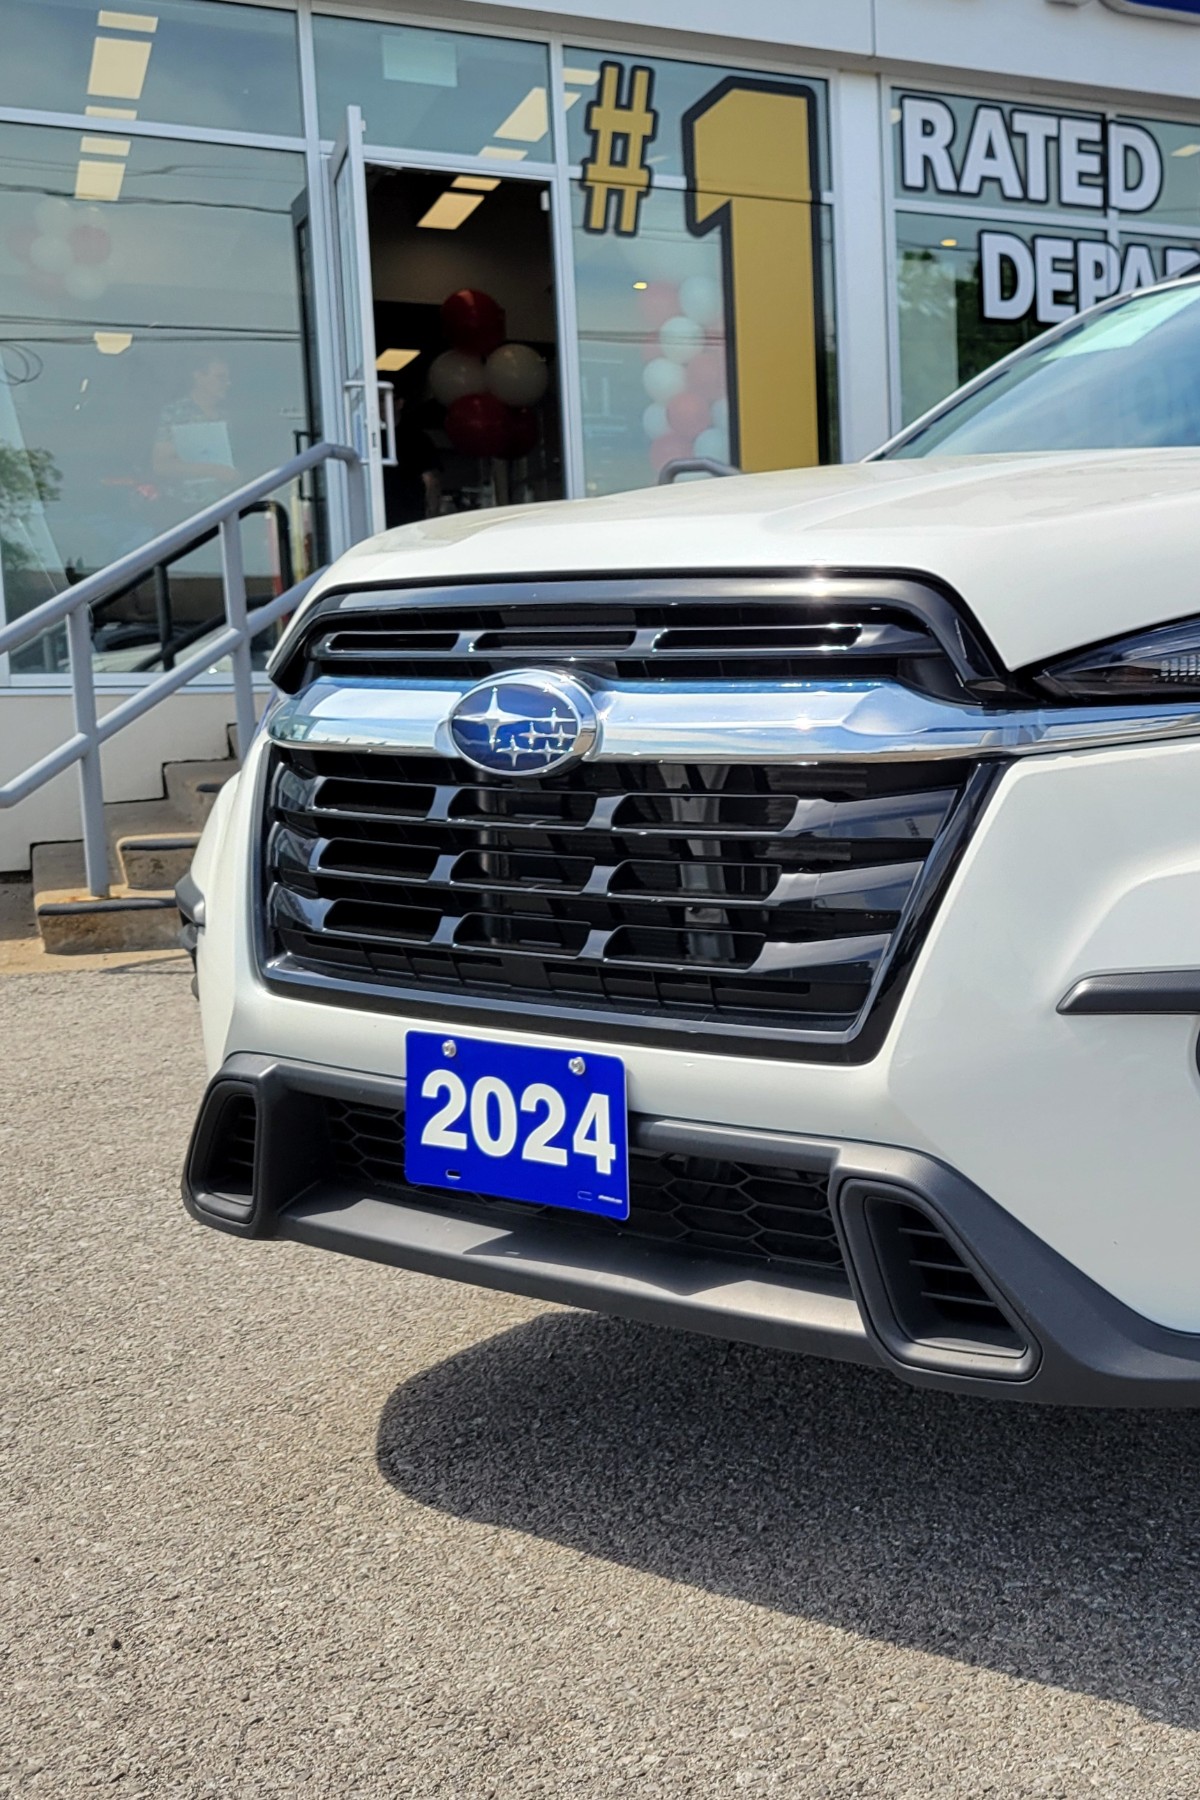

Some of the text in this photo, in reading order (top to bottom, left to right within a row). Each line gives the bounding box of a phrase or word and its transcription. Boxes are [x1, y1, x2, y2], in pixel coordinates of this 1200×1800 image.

[901, 96, 1162, 212] RATED
[580, 62, 827, 471] #1
[420, 1068, 617, 1176] 2024
